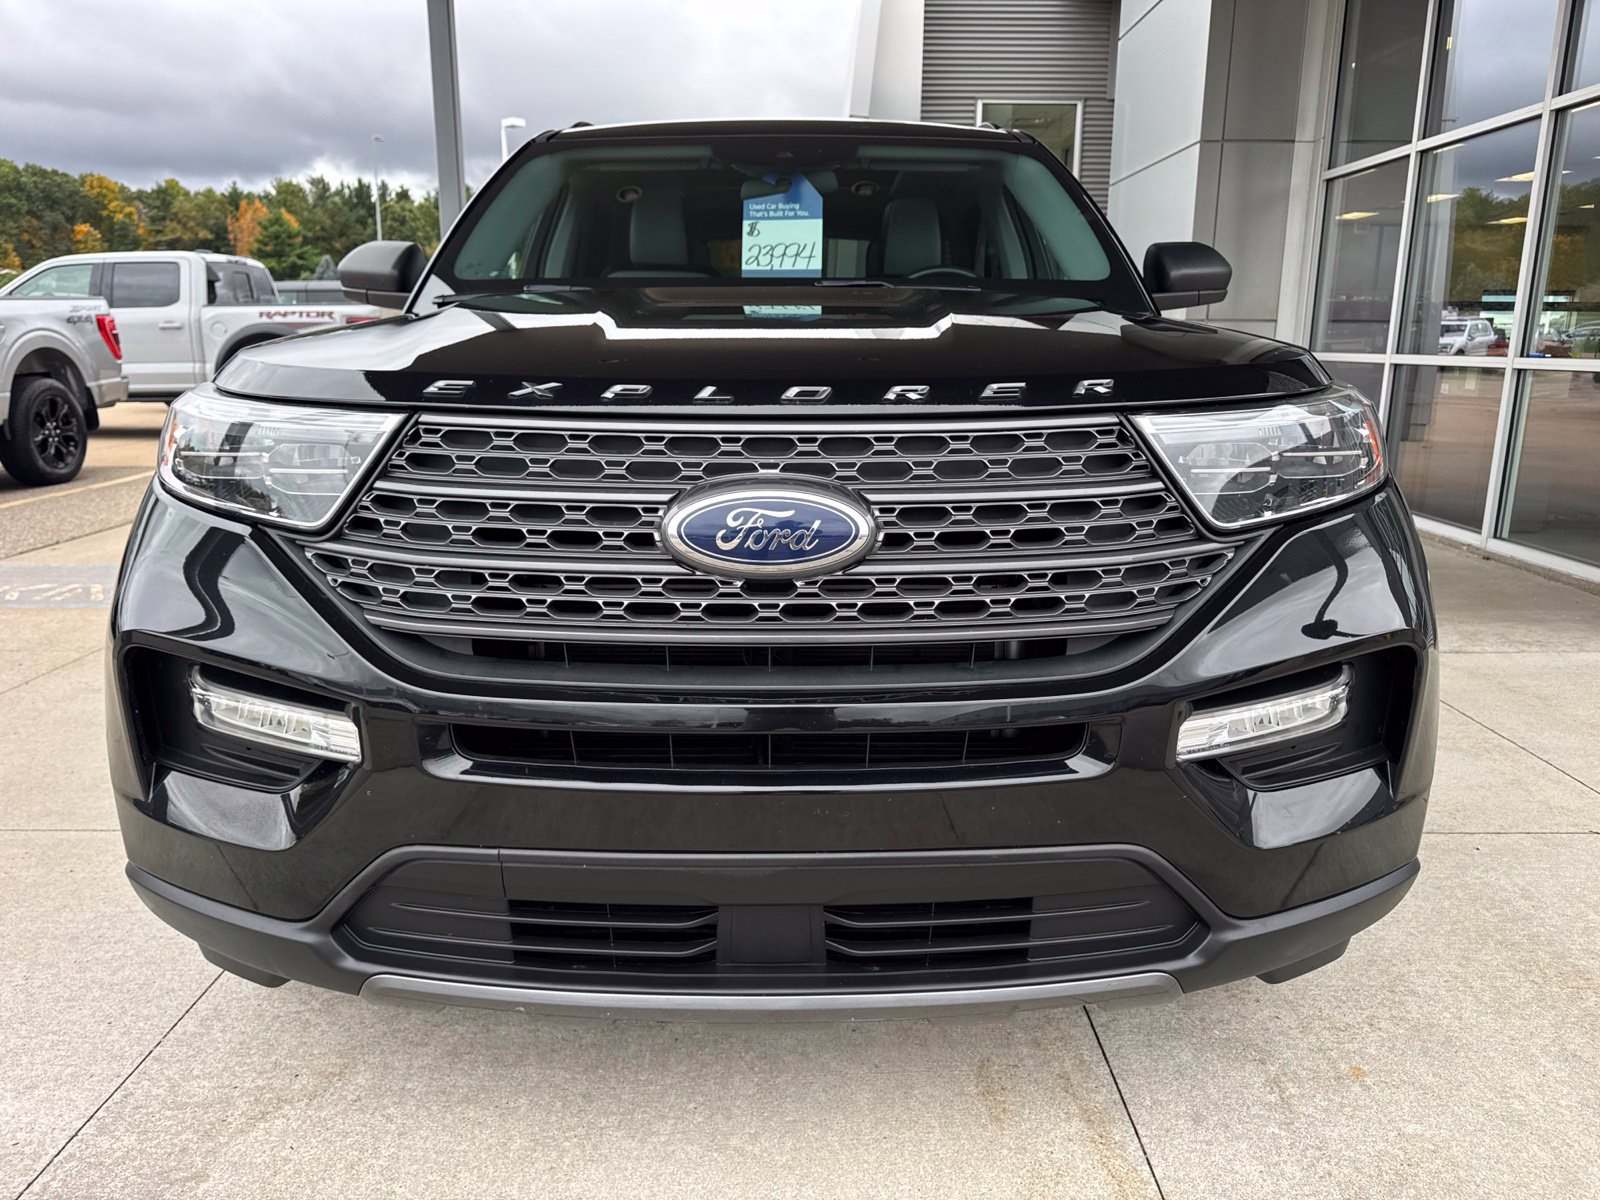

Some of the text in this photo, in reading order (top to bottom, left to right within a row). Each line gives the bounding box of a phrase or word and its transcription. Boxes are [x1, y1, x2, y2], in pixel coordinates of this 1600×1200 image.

[778, 203, 800, 211] Buying
[258, 310, 335, 320] RAPTOR
[422, 378, 1115, 404] EXPLORER
[715, 507, 822, 551] Ford
